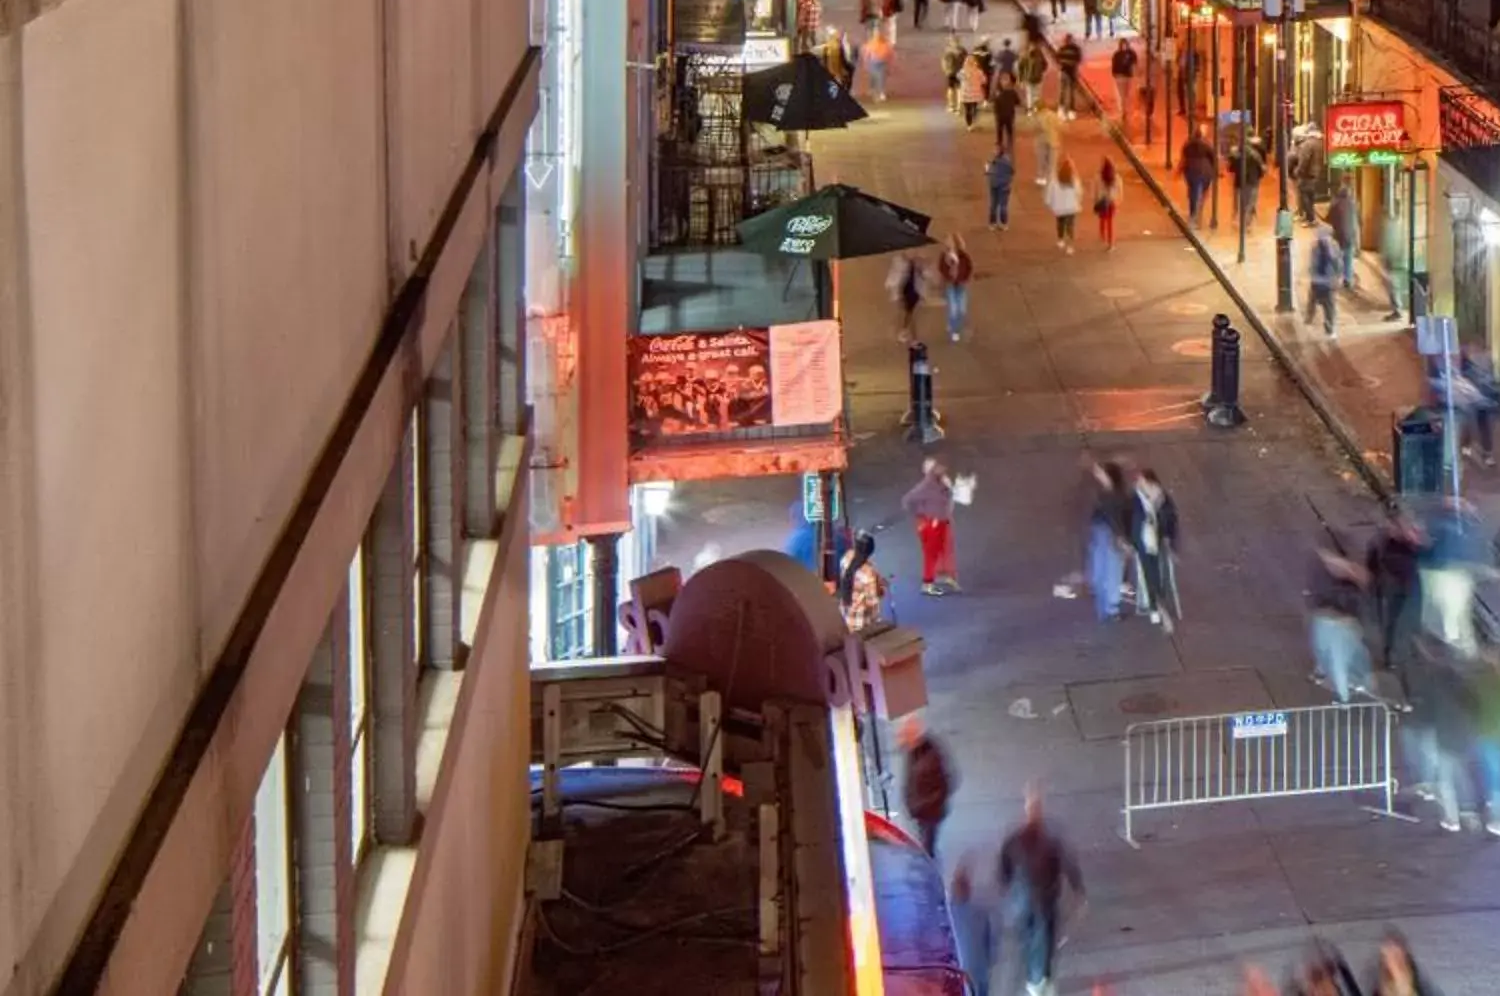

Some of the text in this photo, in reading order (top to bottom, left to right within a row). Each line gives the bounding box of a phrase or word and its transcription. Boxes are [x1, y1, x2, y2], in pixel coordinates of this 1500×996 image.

[1336, 114, 1397, 131] CIGAR
[1332, 129, 1402, 146] FACTORY
[641, 352, 685, 364] Always
[688, 352, 696, 360] a
[698, 348, 731, 361] great
